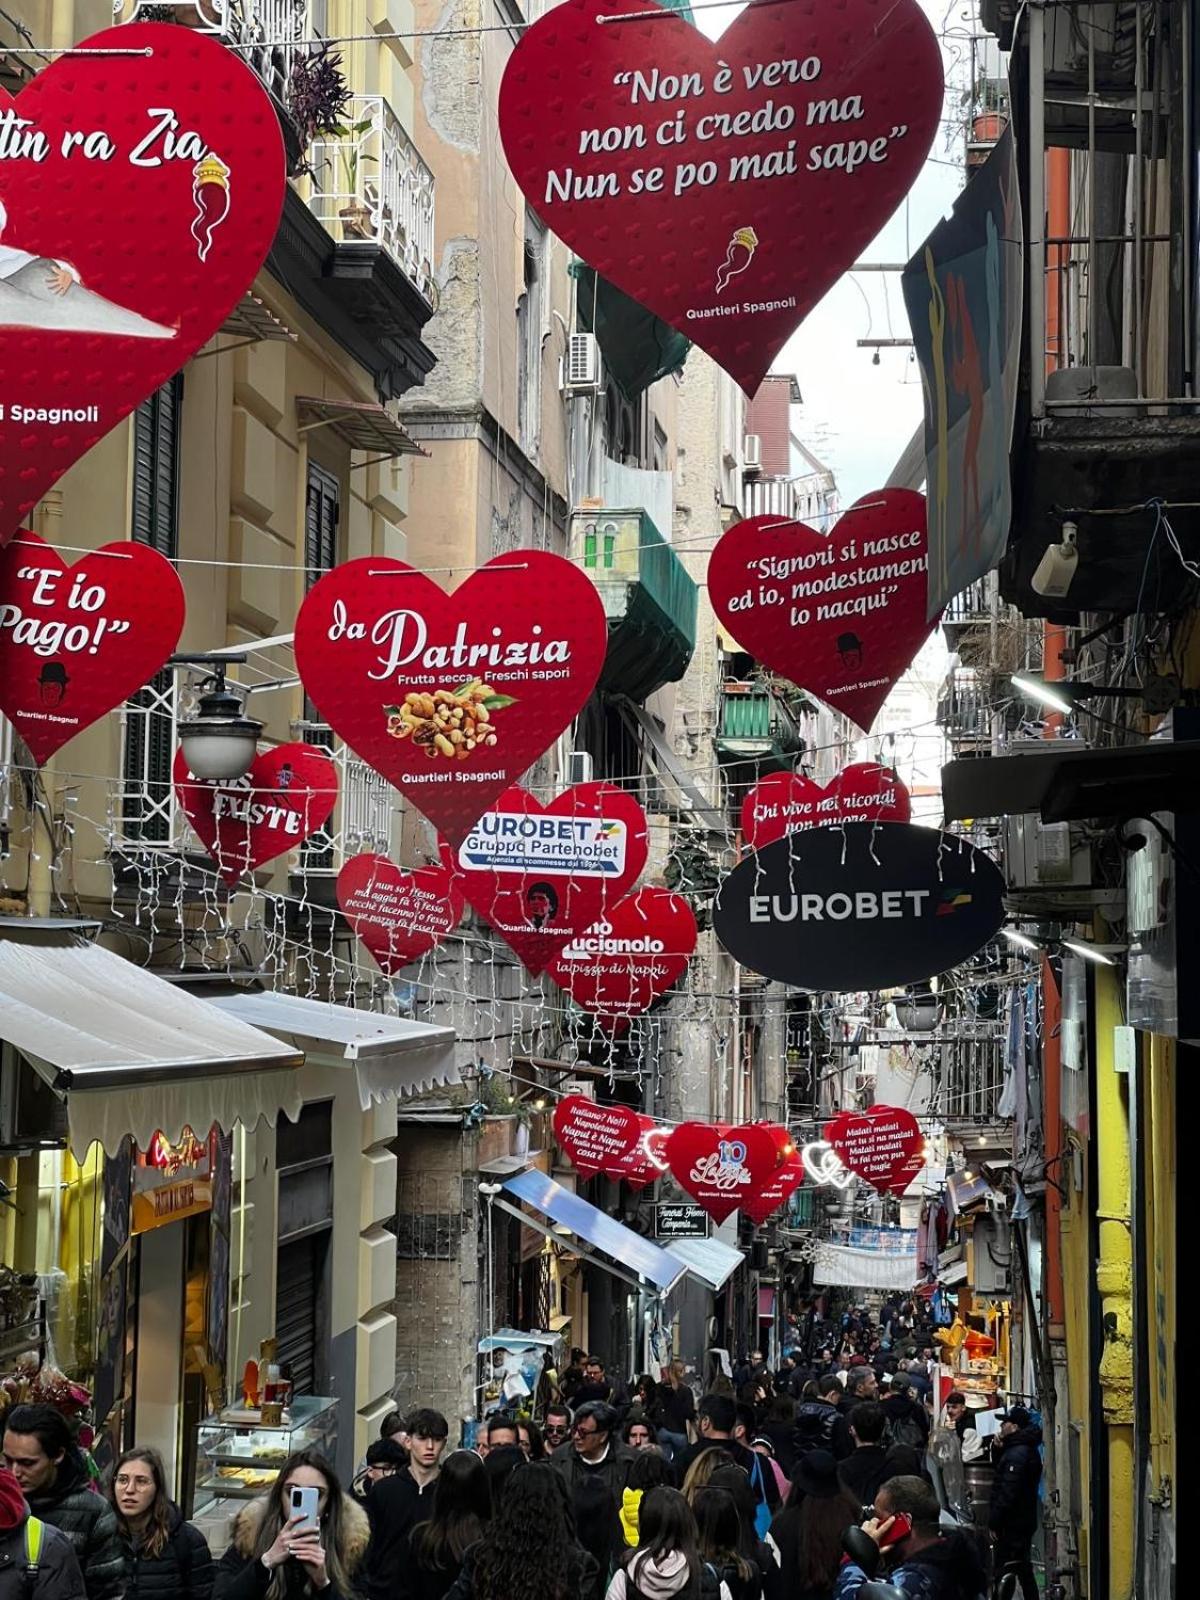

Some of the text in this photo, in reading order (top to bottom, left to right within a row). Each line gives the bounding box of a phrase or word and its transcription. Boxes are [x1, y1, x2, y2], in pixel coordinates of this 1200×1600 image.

[613, 55, 822, 103] “Non è vero
[578, 94, 865, 155] non ci credo ma
[61, 130, 117, 162] ra
[129, 108, 209, 168] Zia
[544, 124, 909, 203] Nun se po mai sape”
[685, 296, 798, 320] Quartieri Spagnoli
[10, 404, 99, 424] Spagnoli
[747, 530, 922, 580] “Signori si nasce
[17, 566, 107, 612] “E io
[727, 590, 754, 613] ed
[758, 586, 786, 606] io,
[789, 584, 899, 627] lo nacqui”
[327, 599, 572, 681] da Patrizia
[397, 666, 571, 686] Frutta secca Freschi sapori
[826, 676, 890, 695] Quartieri Spagnoli
[16, 709, 79, 725] Quartieri Spagnoli
[401, 769, 506, 784] Quartieri Spagnoli
[753, 788, 897, 820] Chi vive nei ricordi
[466, 837, 619, 859] Gruppo Partenobet
[750, 889, 931, 923] EUROBET
[425, 913, 450, 926] fesso
[502, 924, 574, 936] Quartieri Spagnoli
[556, 961, 670, 978] la pizza di Napoli
[718, 1140, 747, 1163] 10
